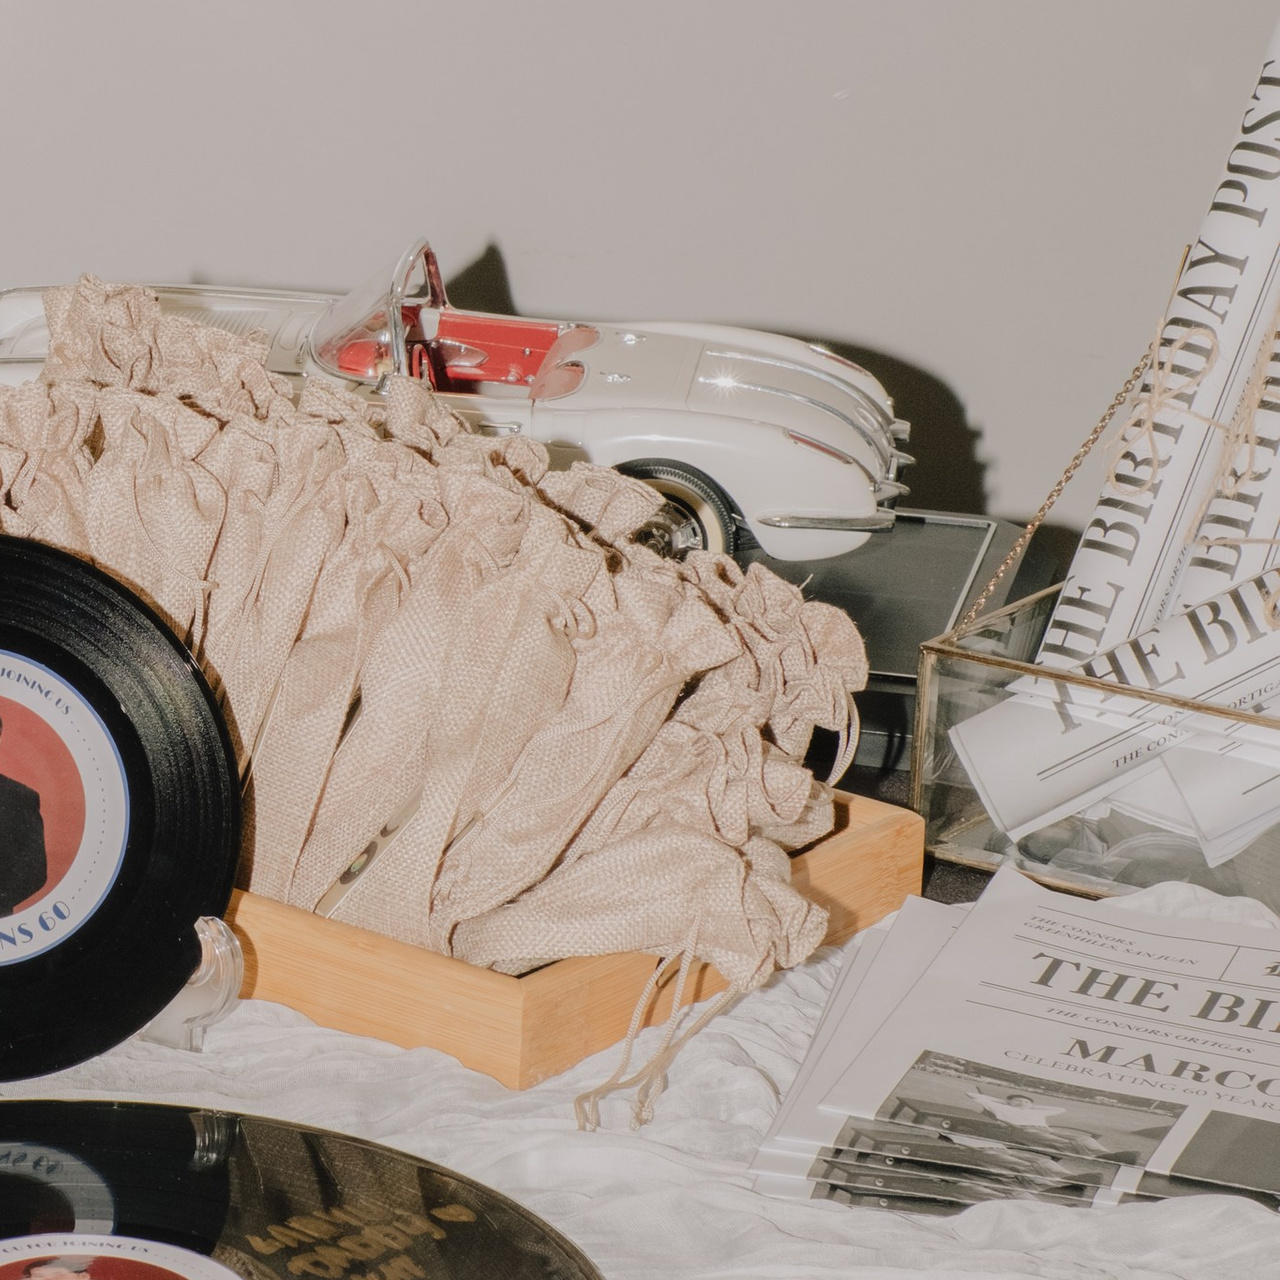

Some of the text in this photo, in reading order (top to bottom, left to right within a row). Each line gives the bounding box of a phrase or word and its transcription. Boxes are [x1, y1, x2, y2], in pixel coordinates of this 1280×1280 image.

[54, 697, 72, 716] US
[37, 898, 72, 933] 60
[1030, 916, 1137, 947] THE CONNORS
[1029, 952, 1280, 1034] THE BI
[1046, 1007, 1256, 1056] THE CONNORS ORTIGAS
[1003, 1048, 1183, 1093] CELEBRATING
[1182, 1087, 1208, 1097] 60
[26, 1241, 58, 1251] FOR
[60, 1240, 128, 1252] JOINING
[131, 1245, 150, 1254] US
